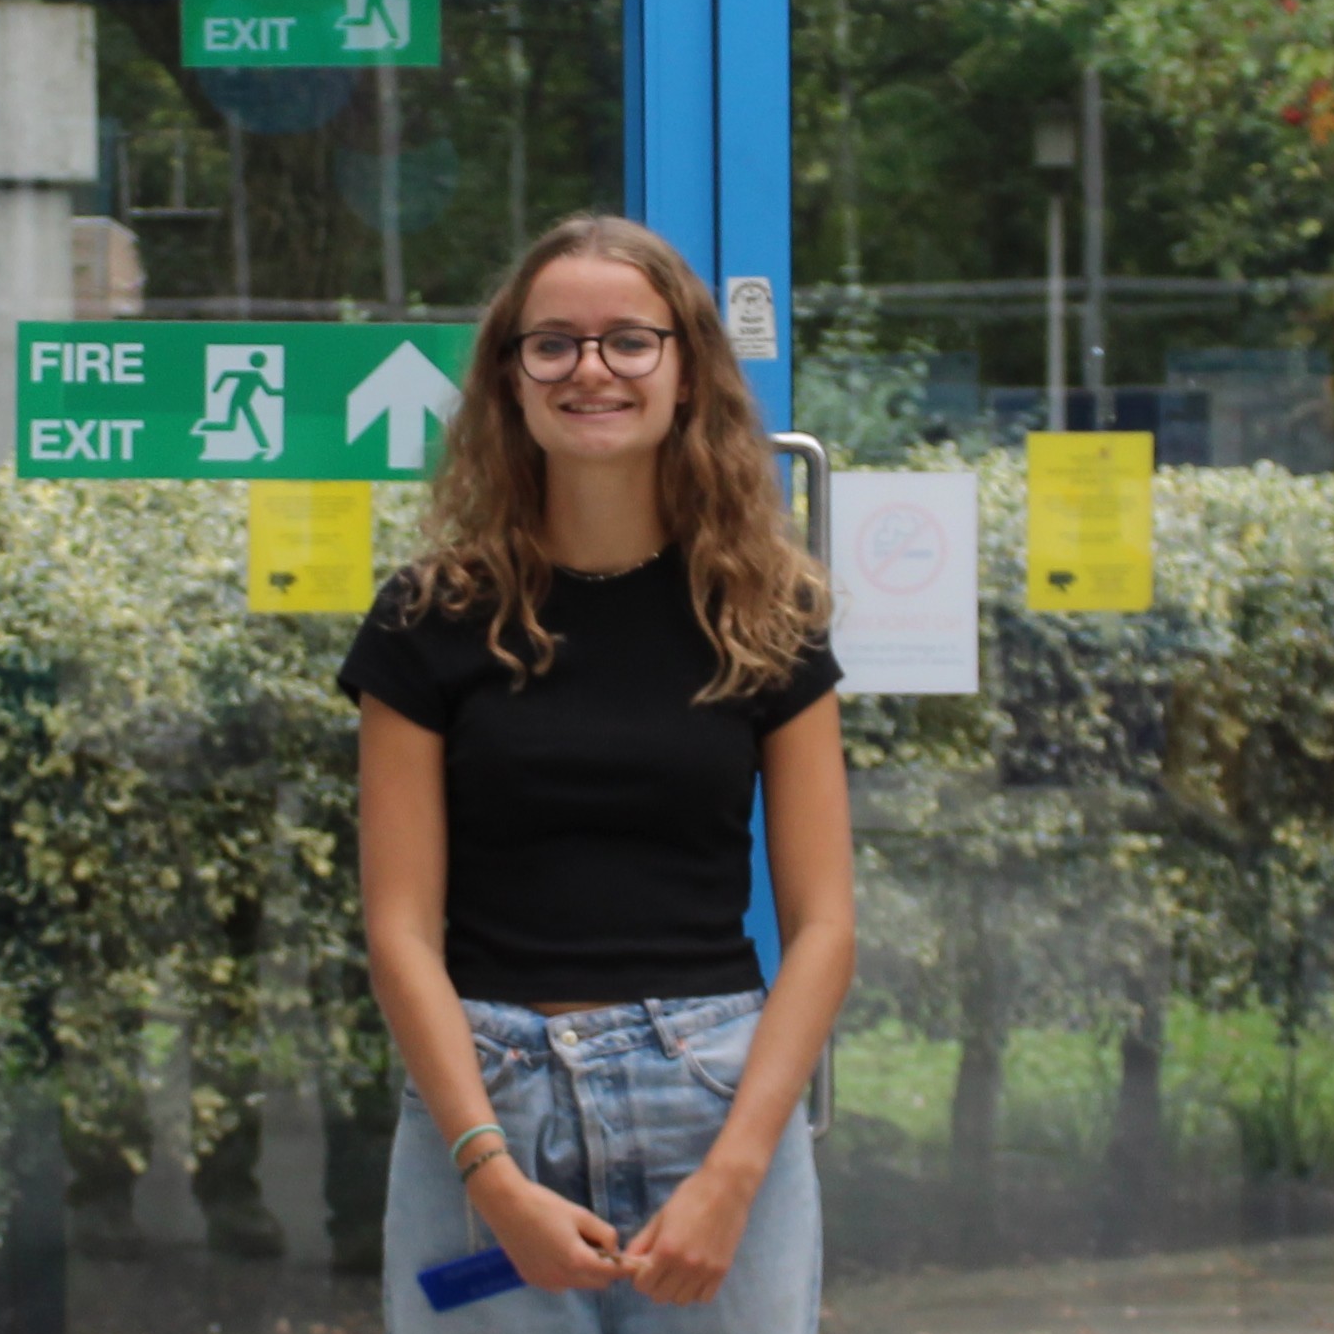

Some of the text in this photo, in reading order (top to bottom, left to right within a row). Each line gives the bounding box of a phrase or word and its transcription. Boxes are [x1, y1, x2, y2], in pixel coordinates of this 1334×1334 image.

[203, 16, 297, 52] EXIT
[30, 341, 146, 383] FIRE
[30, 419, 146, 461] EXIT
